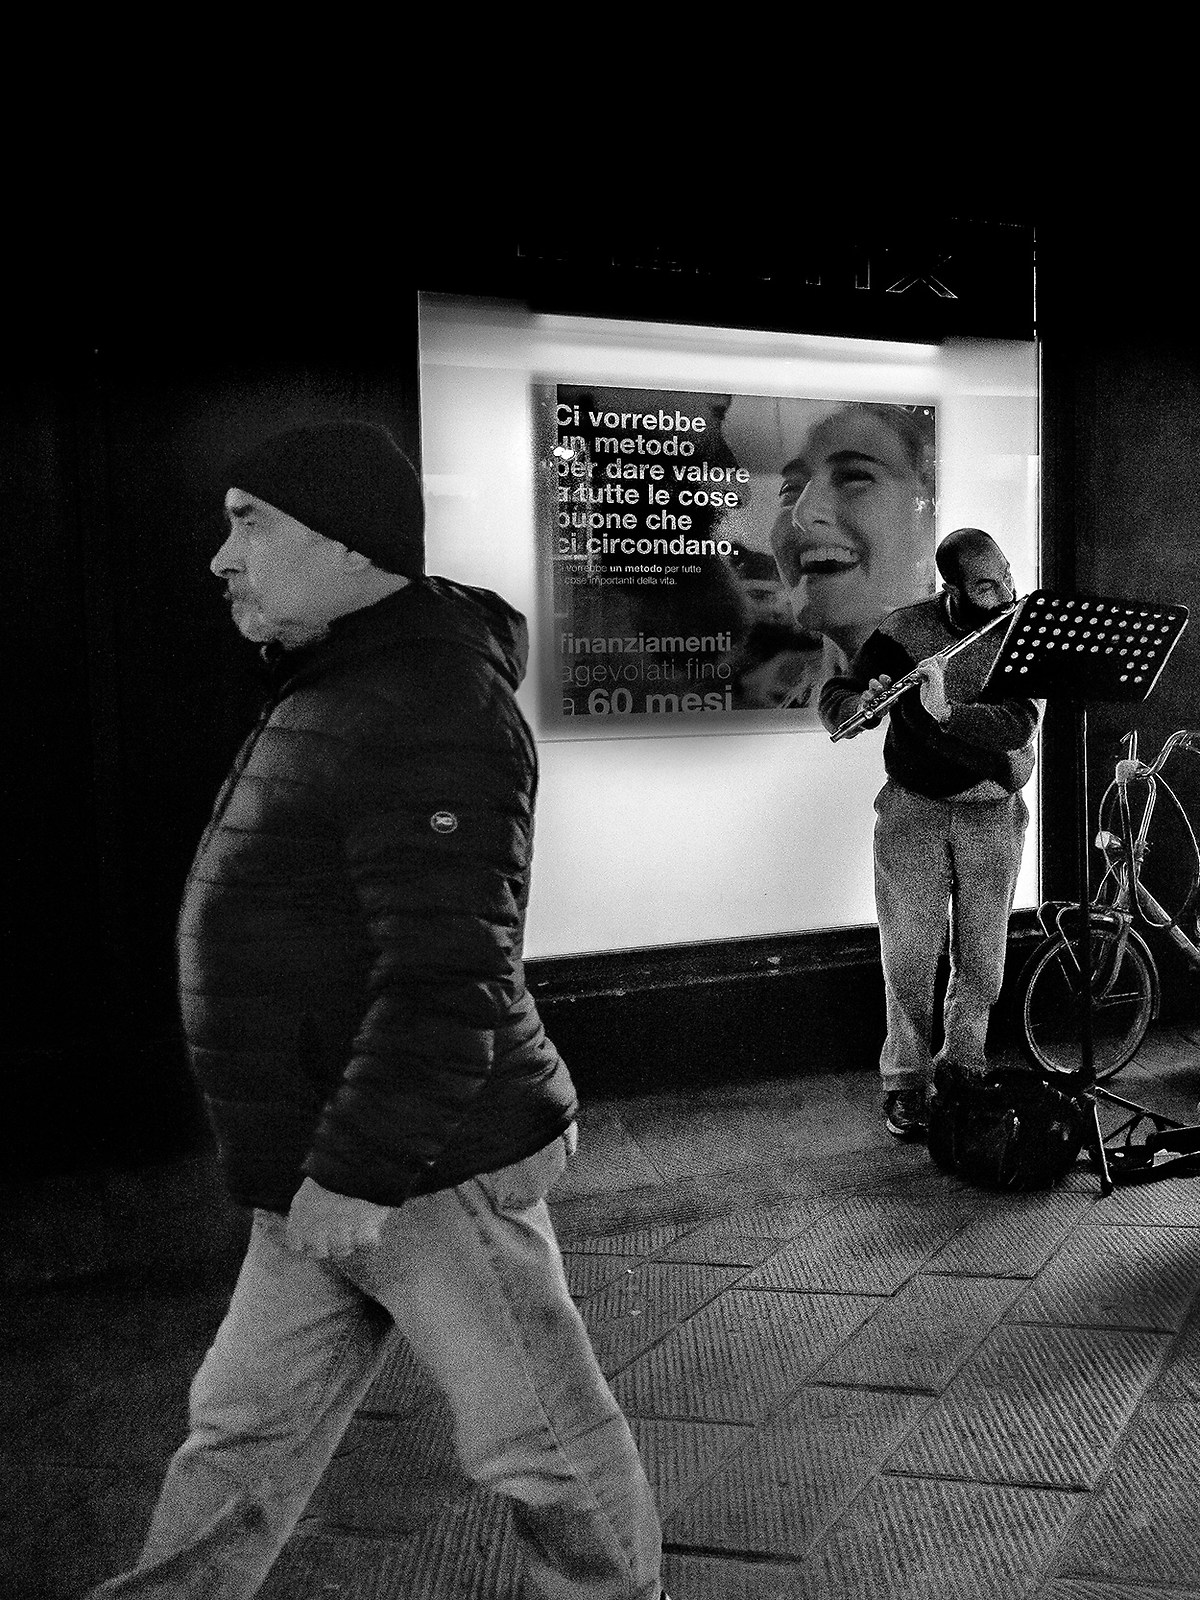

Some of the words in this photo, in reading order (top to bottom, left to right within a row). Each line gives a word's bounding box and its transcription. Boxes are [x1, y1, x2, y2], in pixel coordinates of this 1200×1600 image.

[556, 404, 580, 427] Ci
[588, 410, 707, 432] vorrebbe
[595, 434, 695, 456] metodo
[605, 458, 665, 479] dare
[672, 462, 750, 483] valore
[576, 482, 640, 505] tutte
[649, 484, 670, 506] le
[678, 489, 739, 507] cose
[646, 510, 692, 531] che
[586, 533, 739, 556] circondano.
[589, 576, 635, 586] importanti
[637, 576, 658, 585] della
[659, 576, 678, 586] vita.
[609, 565, 622, 573] un
[625, 564, 662, 573] metodo
[664, 565, 679, 575] per
[681, 564, 702, 573] tutte
[561, 631, 731, 654] finanziamenti
[562, 659, 675, 687] agevolati
[685, 657, 731, 680] fino
[588, 687, 634, 715] 60
[646, 684, 732, 714] mesi
